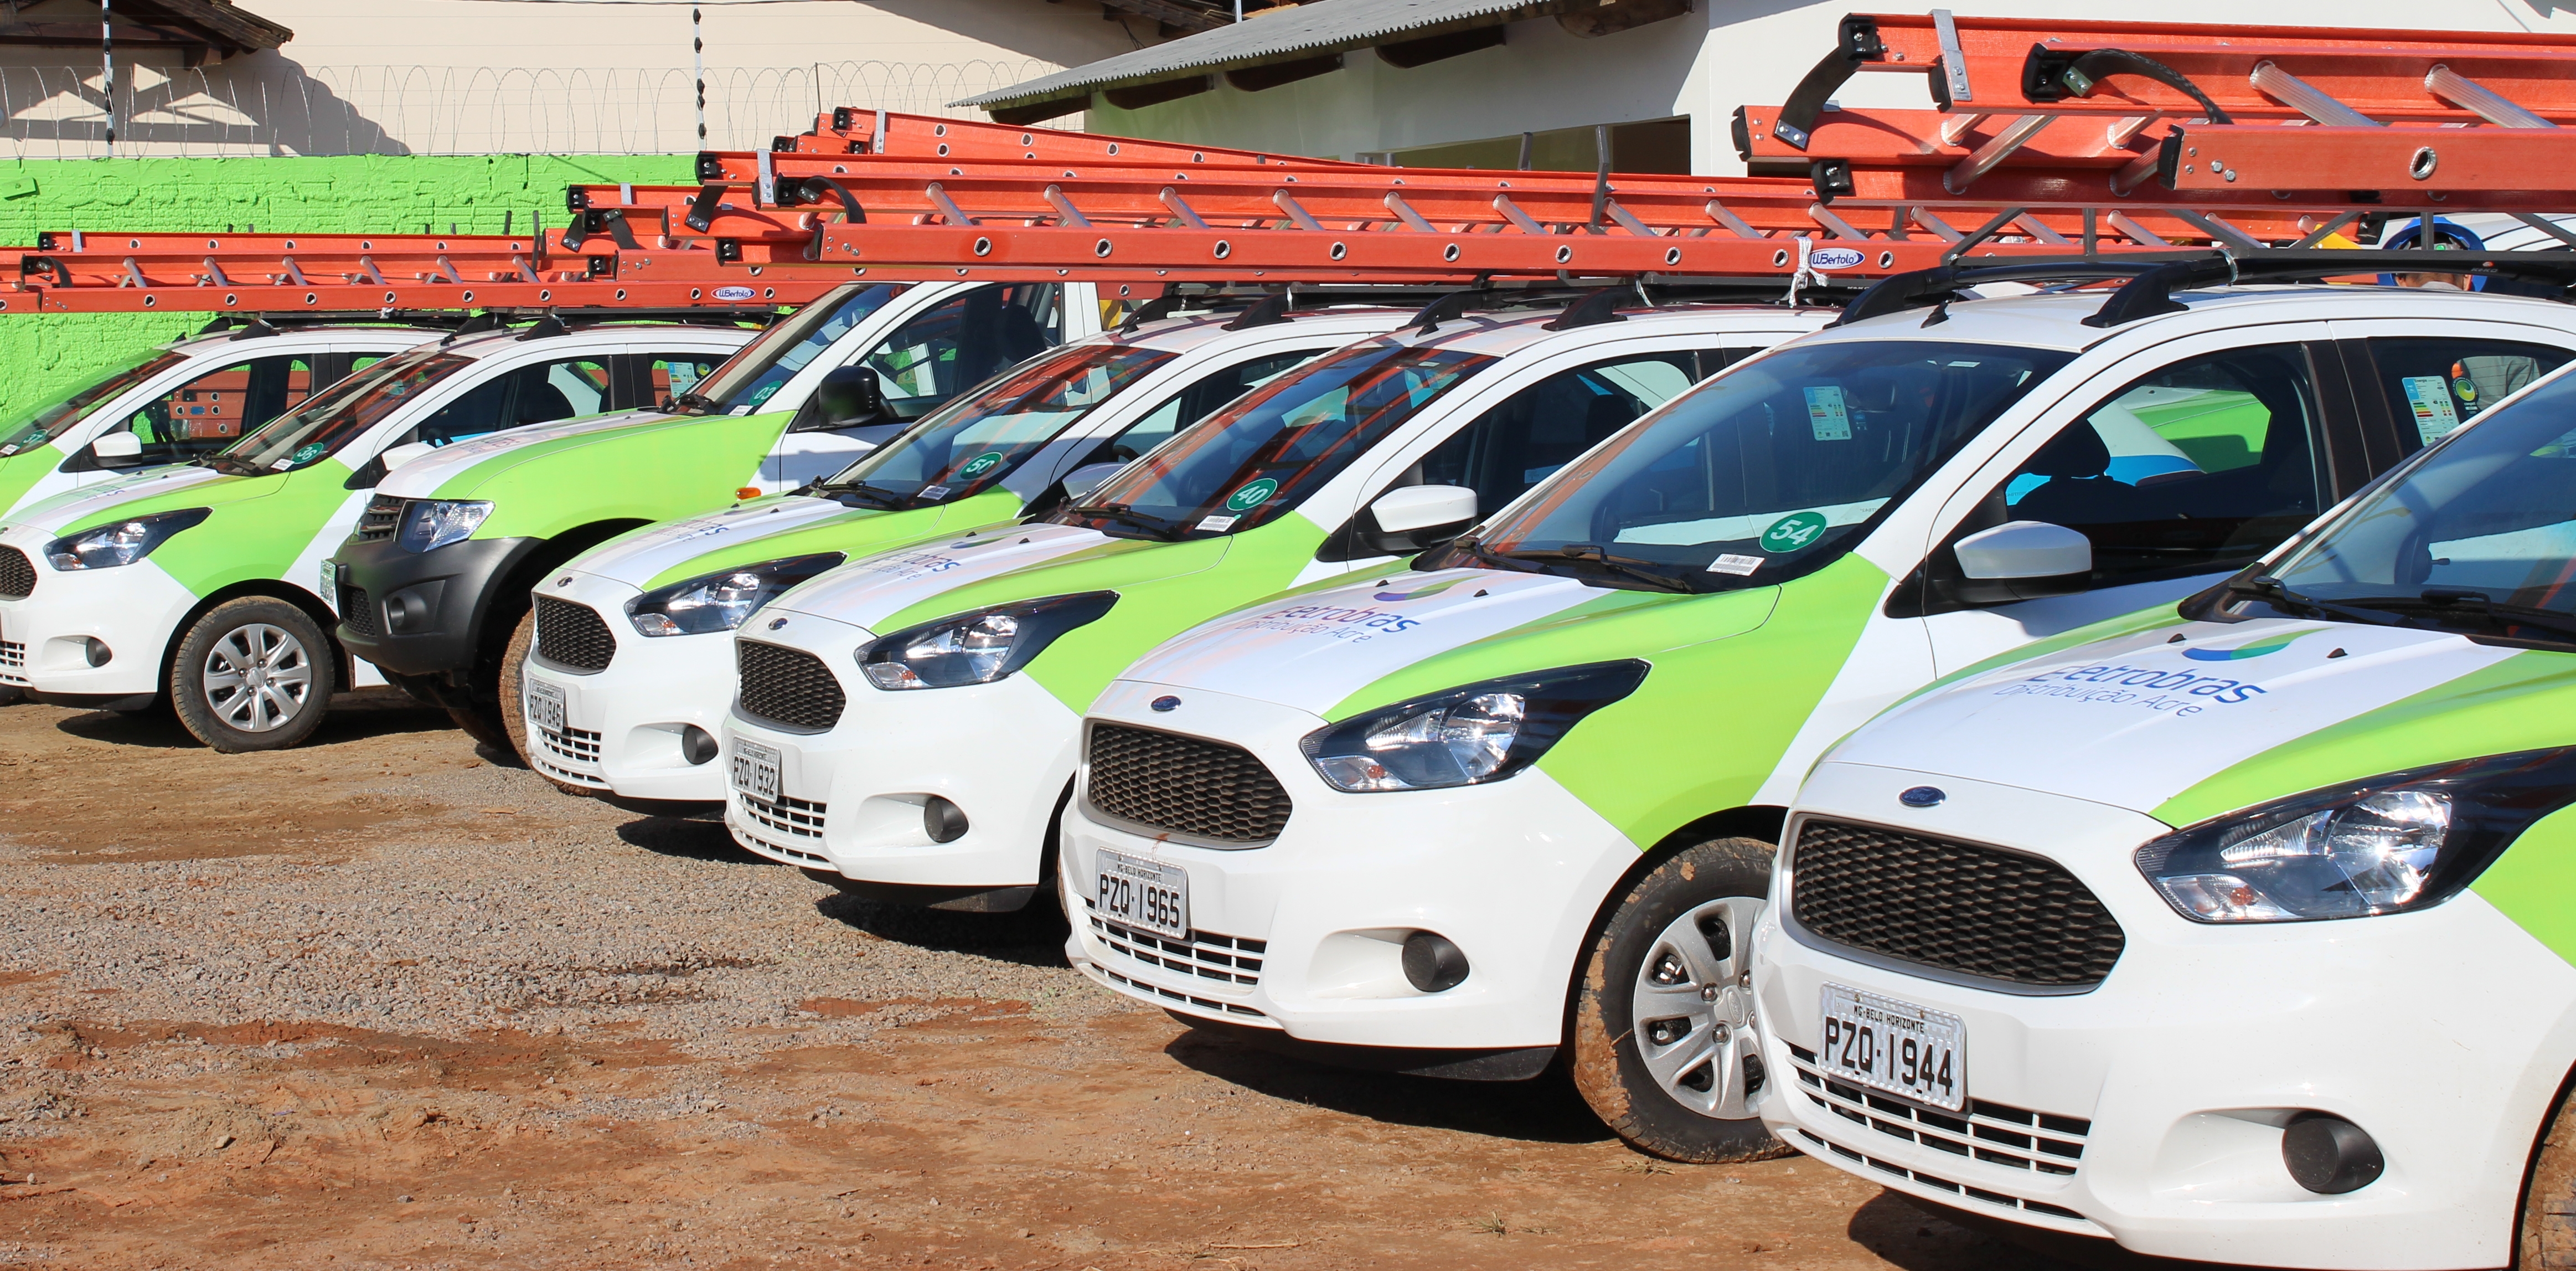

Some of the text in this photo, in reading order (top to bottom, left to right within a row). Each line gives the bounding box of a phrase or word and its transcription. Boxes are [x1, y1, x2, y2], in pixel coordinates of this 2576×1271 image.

[753, 387, 776, 400] 03
[23, 433, 44, 444] 37
[297, 446, 318, 460] 36
[966, 459, 995, 474] 50
[1237, 485, 1268, 505] 40
[1770, 519, 1819, 546] 54
[1235, 620, 1372, 643] Dstribuição Acre
[2130, 694, 2203, 717] Acre
[1138, 869, 1161, 882] HORIZONTE
[1887, 1014, 1924, 1033] HORIZONTE
